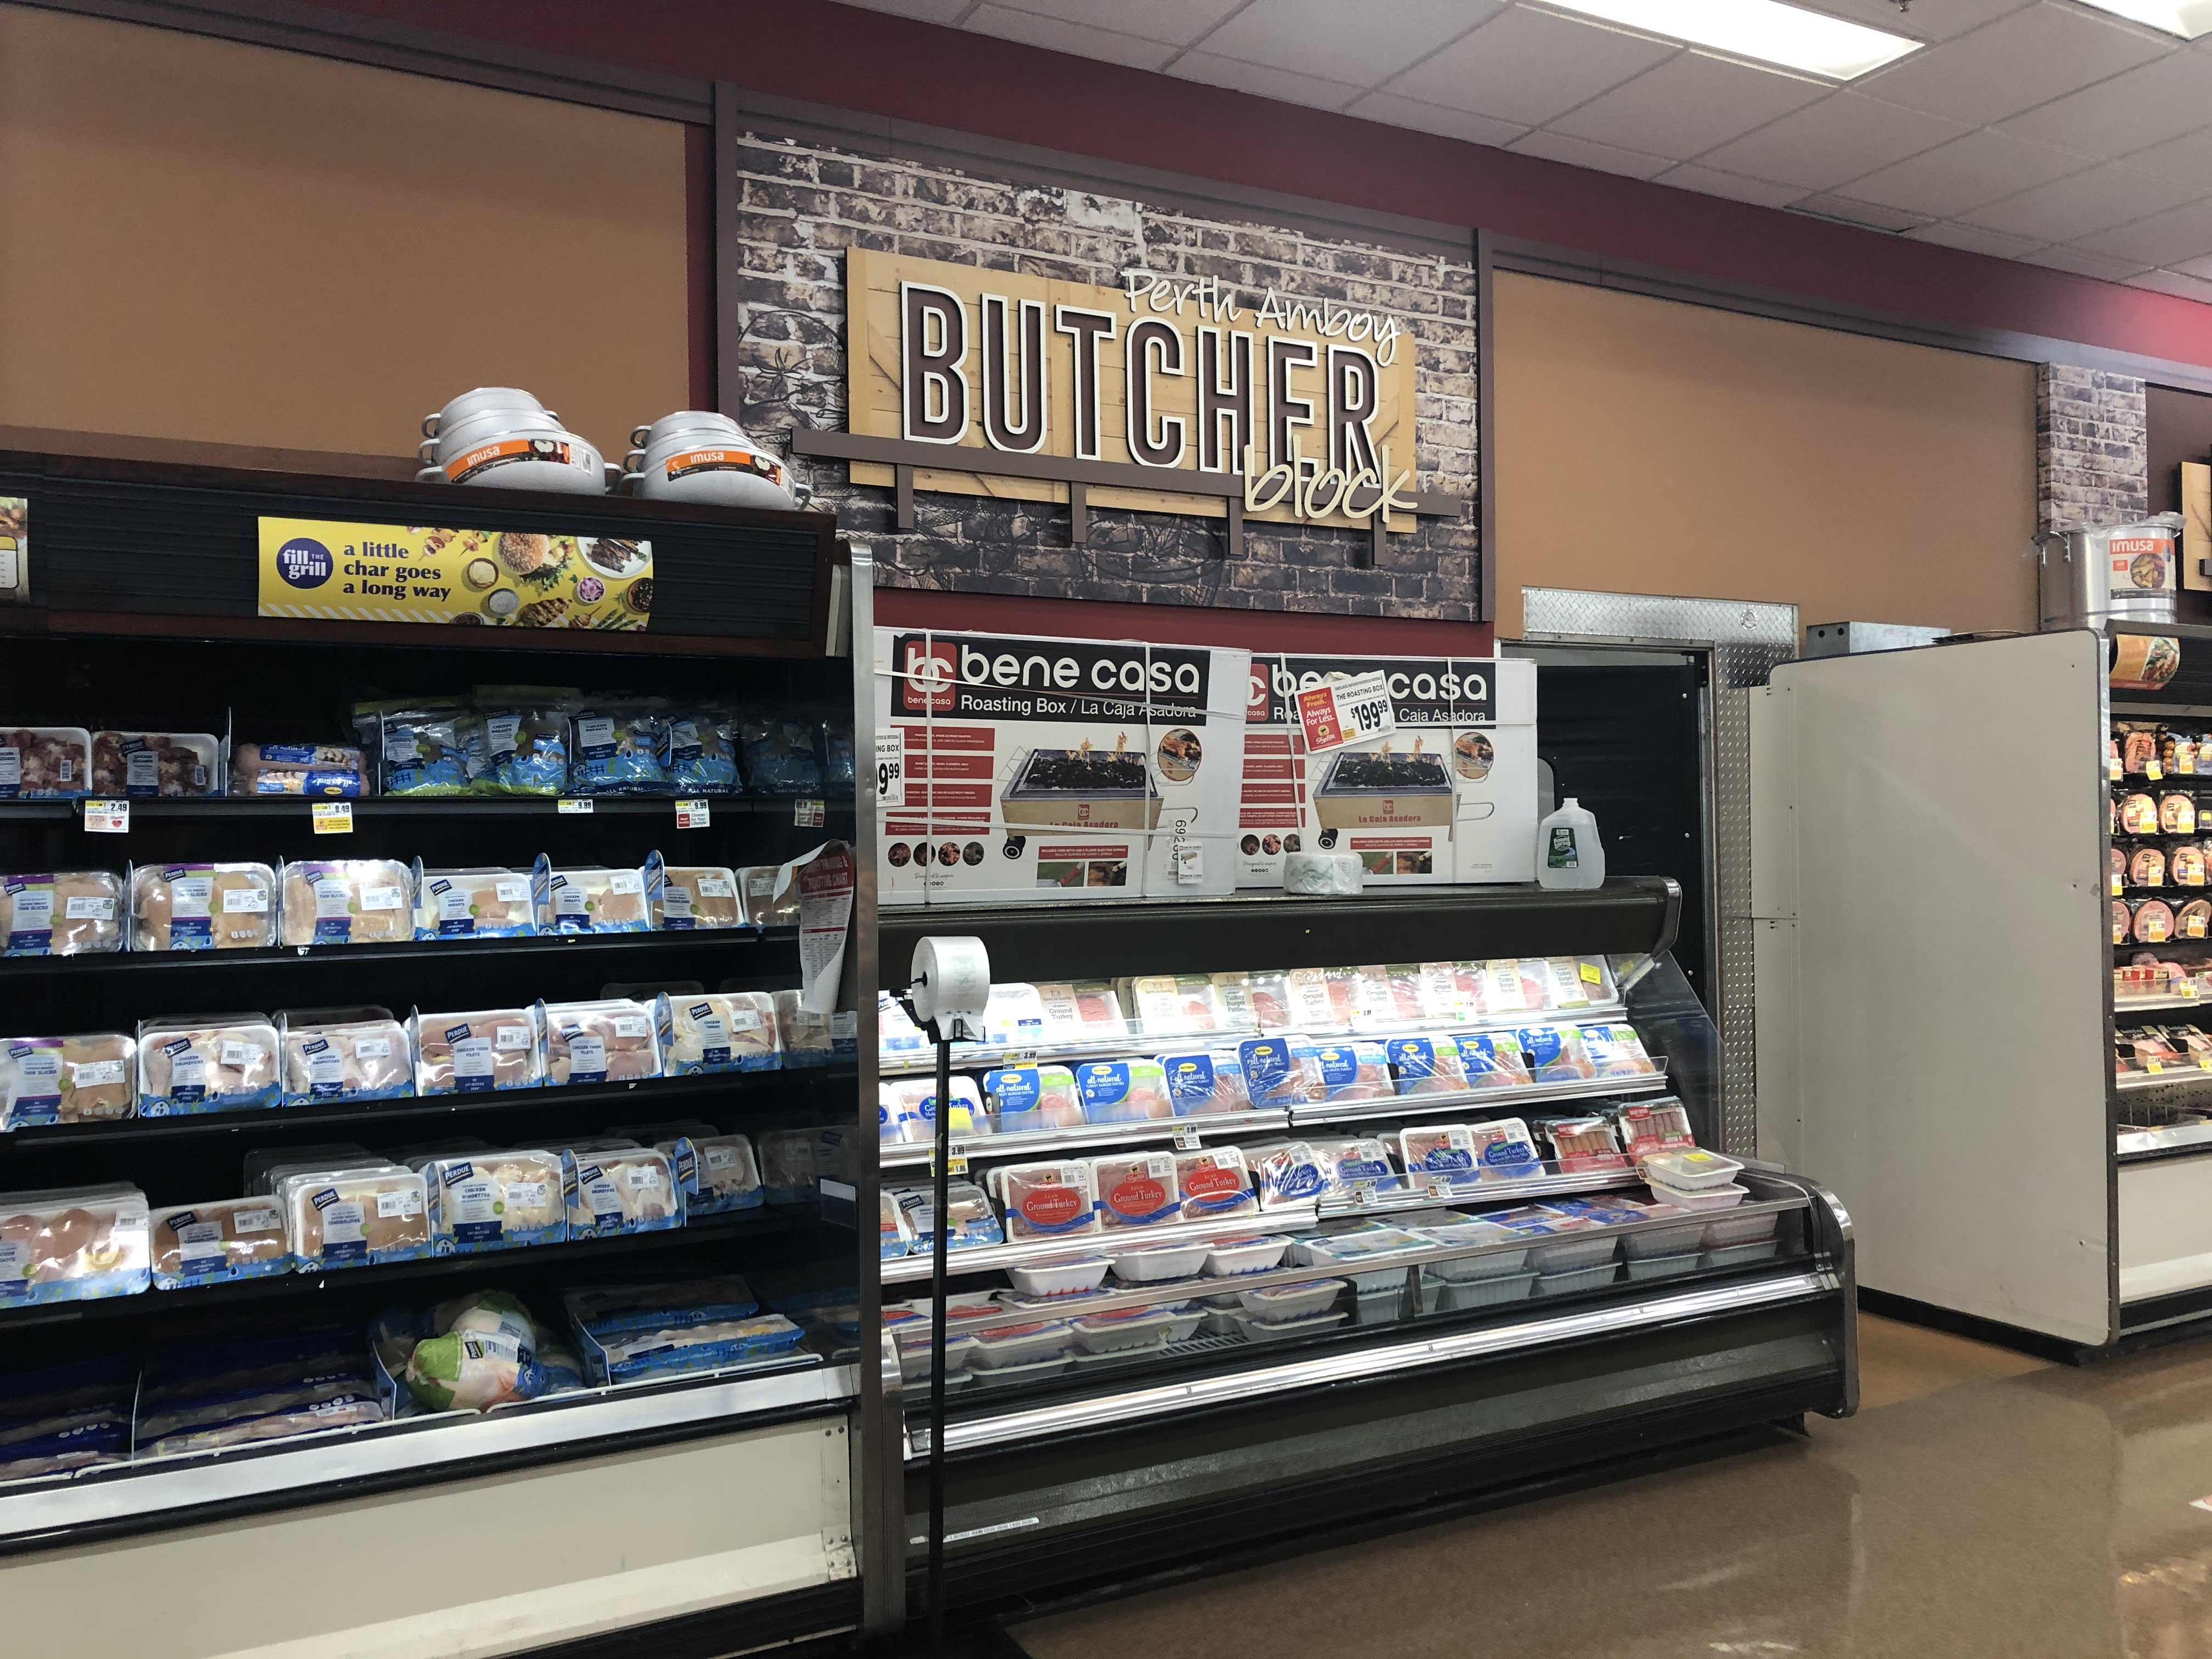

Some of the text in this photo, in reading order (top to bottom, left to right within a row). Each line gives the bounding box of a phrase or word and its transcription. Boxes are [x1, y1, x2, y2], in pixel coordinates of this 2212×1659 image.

[1121, 268, 1400, 368] Perth Amboy
[900, 280, 1381, 489] BUTCHER
[1243, 435, 1418, 524] block
[343, 541, 409, 558] a little
[283, 549, 308, 565] fill
[288, 561, 326, 579] grill
[344, 560, 441, 583] char goes
[343, 579, 452, 602] a long way
[961, 645, 1200, 693] bene casa
[1347, 687, 1372, 698] ROASTING
[1373, 684, 1383, 692] BOX
[1387, 673, 1487, 700] casa
[1303, 692, 1327, 702] Always
[961, 695, 1031, 715] Roasting
[1036, 697, 1066, 713] Box
[1081, 700, 1098, 714] La
[1103, 702, 1135, 718] Caja
[1306, 699, 1327, 708] Fresh.
[1306, 707, 1331, 718] Always
[1399, 709, 1486, 722] Caja Asadora
[1306, 714, 1335, 726] For Less.
[887, 744, 899, 752] BOX
[111, 803, 127, 811] 2.49
[335, 805, 350, 813] 8.49
[165, 870, 184, 878] PERDUE
[832, 872, 848, 886] CHART
[6, 883, 22, 891] PERDUE
[432, 881, 448, 891] PERDUE
[550, 877, 564, 887] ERDUE
[691, 1005, 709, 1015] PERDUE
[447, 1026, 467, 1039] PERDUE
[1534, 1035, 1554, 1043] natural
[11, 1047, 30, 1056] PERDUE
[166, 1040, 188, 1053] PERDUE
[304, 1041, 326, 1051] PERDUE
[1260, 1054, 1282, 1064] natural
[1325, 1059, 1349, 1069] natural
[1087, 1074, 1122, 1085] all natural
[1174, 1072, 1206, 1082] all natural
[996, 1082, 1031, 1093] all natural
[678, 1157, 693, 1172] PERDUE
[445, 1165, 470, 1180] PERDUE
[580, 1169, 601, 1180] PERDUE
[1189, 1178, 1235, 1191] Ground Turkey
[314, 1190, 335, 1204] PERDUE
[902, 1197, 921, 1206] PERDUE
[1114, 1190, 1163, 1203] Ground Turkey
[1026, 1199, 1077, 1211] Ground Turkey
[169, 1213, 192, 1226] PERDUE
